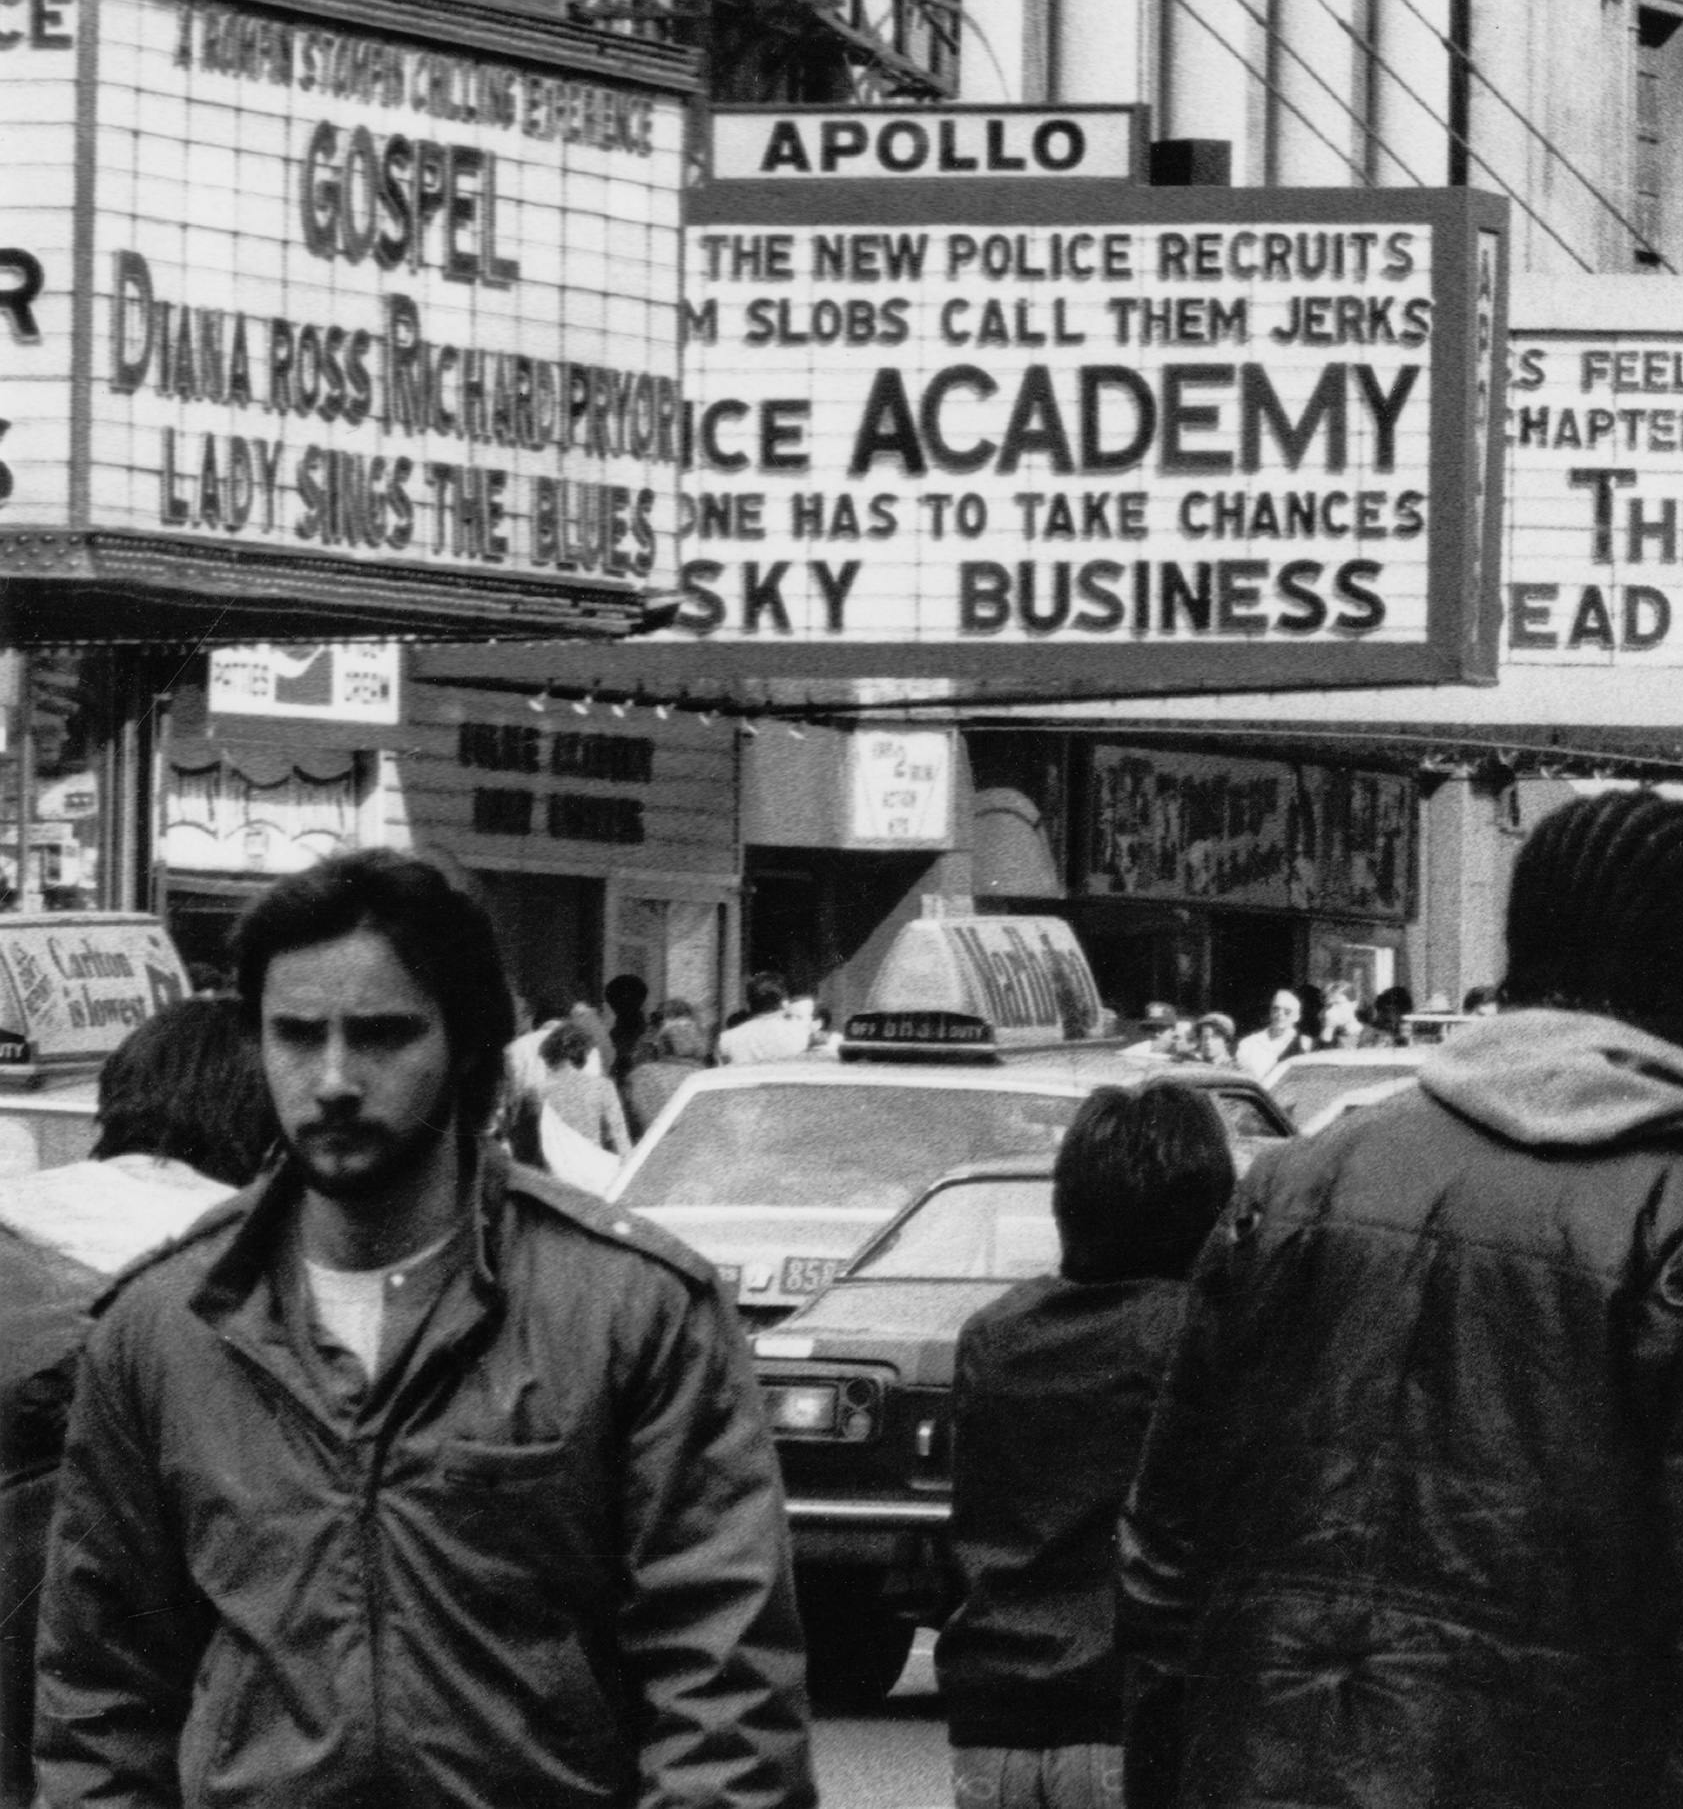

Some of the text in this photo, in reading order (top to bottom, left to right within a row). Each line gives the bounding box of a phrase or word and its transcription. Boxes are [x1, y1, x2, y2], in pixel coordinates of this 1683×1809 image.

[761, 120, 1086, 173] APOLLO
[301, 120, 519, 289] GOSPEL
[701, 232, 1415, 282] THE NEW POLICE RECRUITS
[114, 250, 251, 409] DIANA
[264, 317, 372, 425] ROSS
[381, 294, 557, 453] RICHARD
[744, 297, 910, 346] SLOBS
[941, 297, 1085, 346] CALL
[1108, 297, 1246, 346] THEM
[1270, 297, 1431, 346] JERKS
[846, 363, 1421, 477] ACADEMY
[161, 426, 656, 576] LADY SINGS THE BLUES
[791, 491, 898, 542] HAS
[927, 491, 988, 542] TO
[1014, 491, 1149, 542] TAKE
[1178, 491, 1424, 542] CHANCES
[959, 559, 1386, 637] BUSINESS
[1507, 581, 1671, 653] EAD
